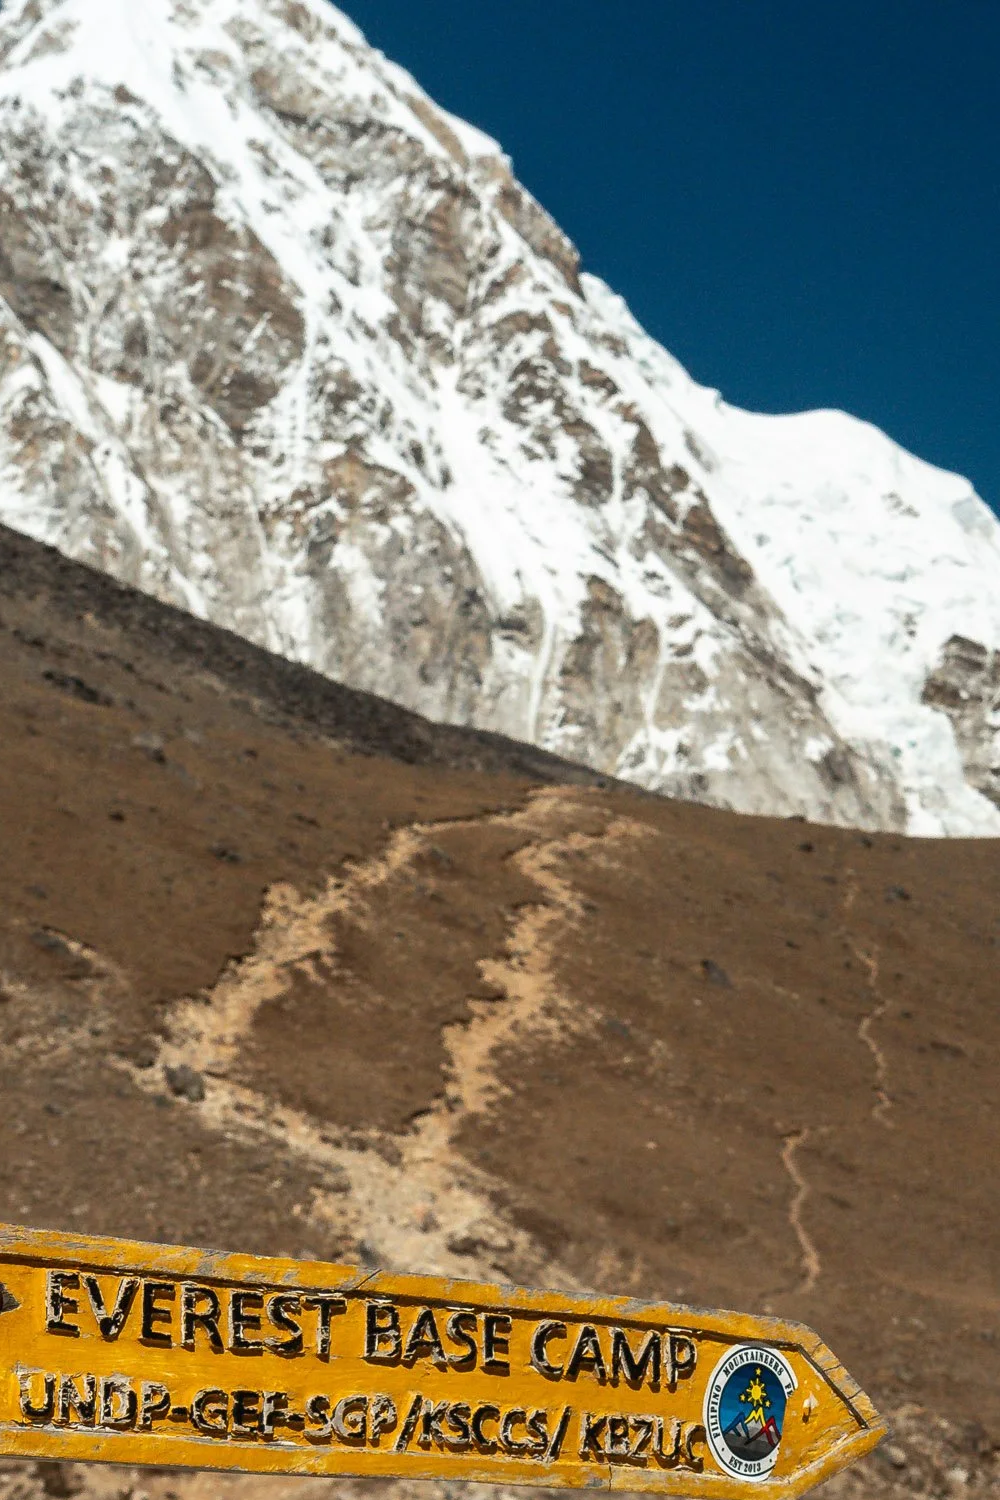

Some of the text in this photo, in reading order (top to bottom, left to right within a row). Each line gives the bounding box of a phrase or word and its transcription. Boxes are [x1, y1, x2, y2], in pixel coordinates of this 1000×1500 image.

[46, 1270, 697, 1388] EVEREST BASE CAMP
[711, 1384, 722, 1440] FILIPINO
[723, 1351, 784, 1378] MOUNTAINEERS
[728, 1456, 761, 1473] EST 2013
